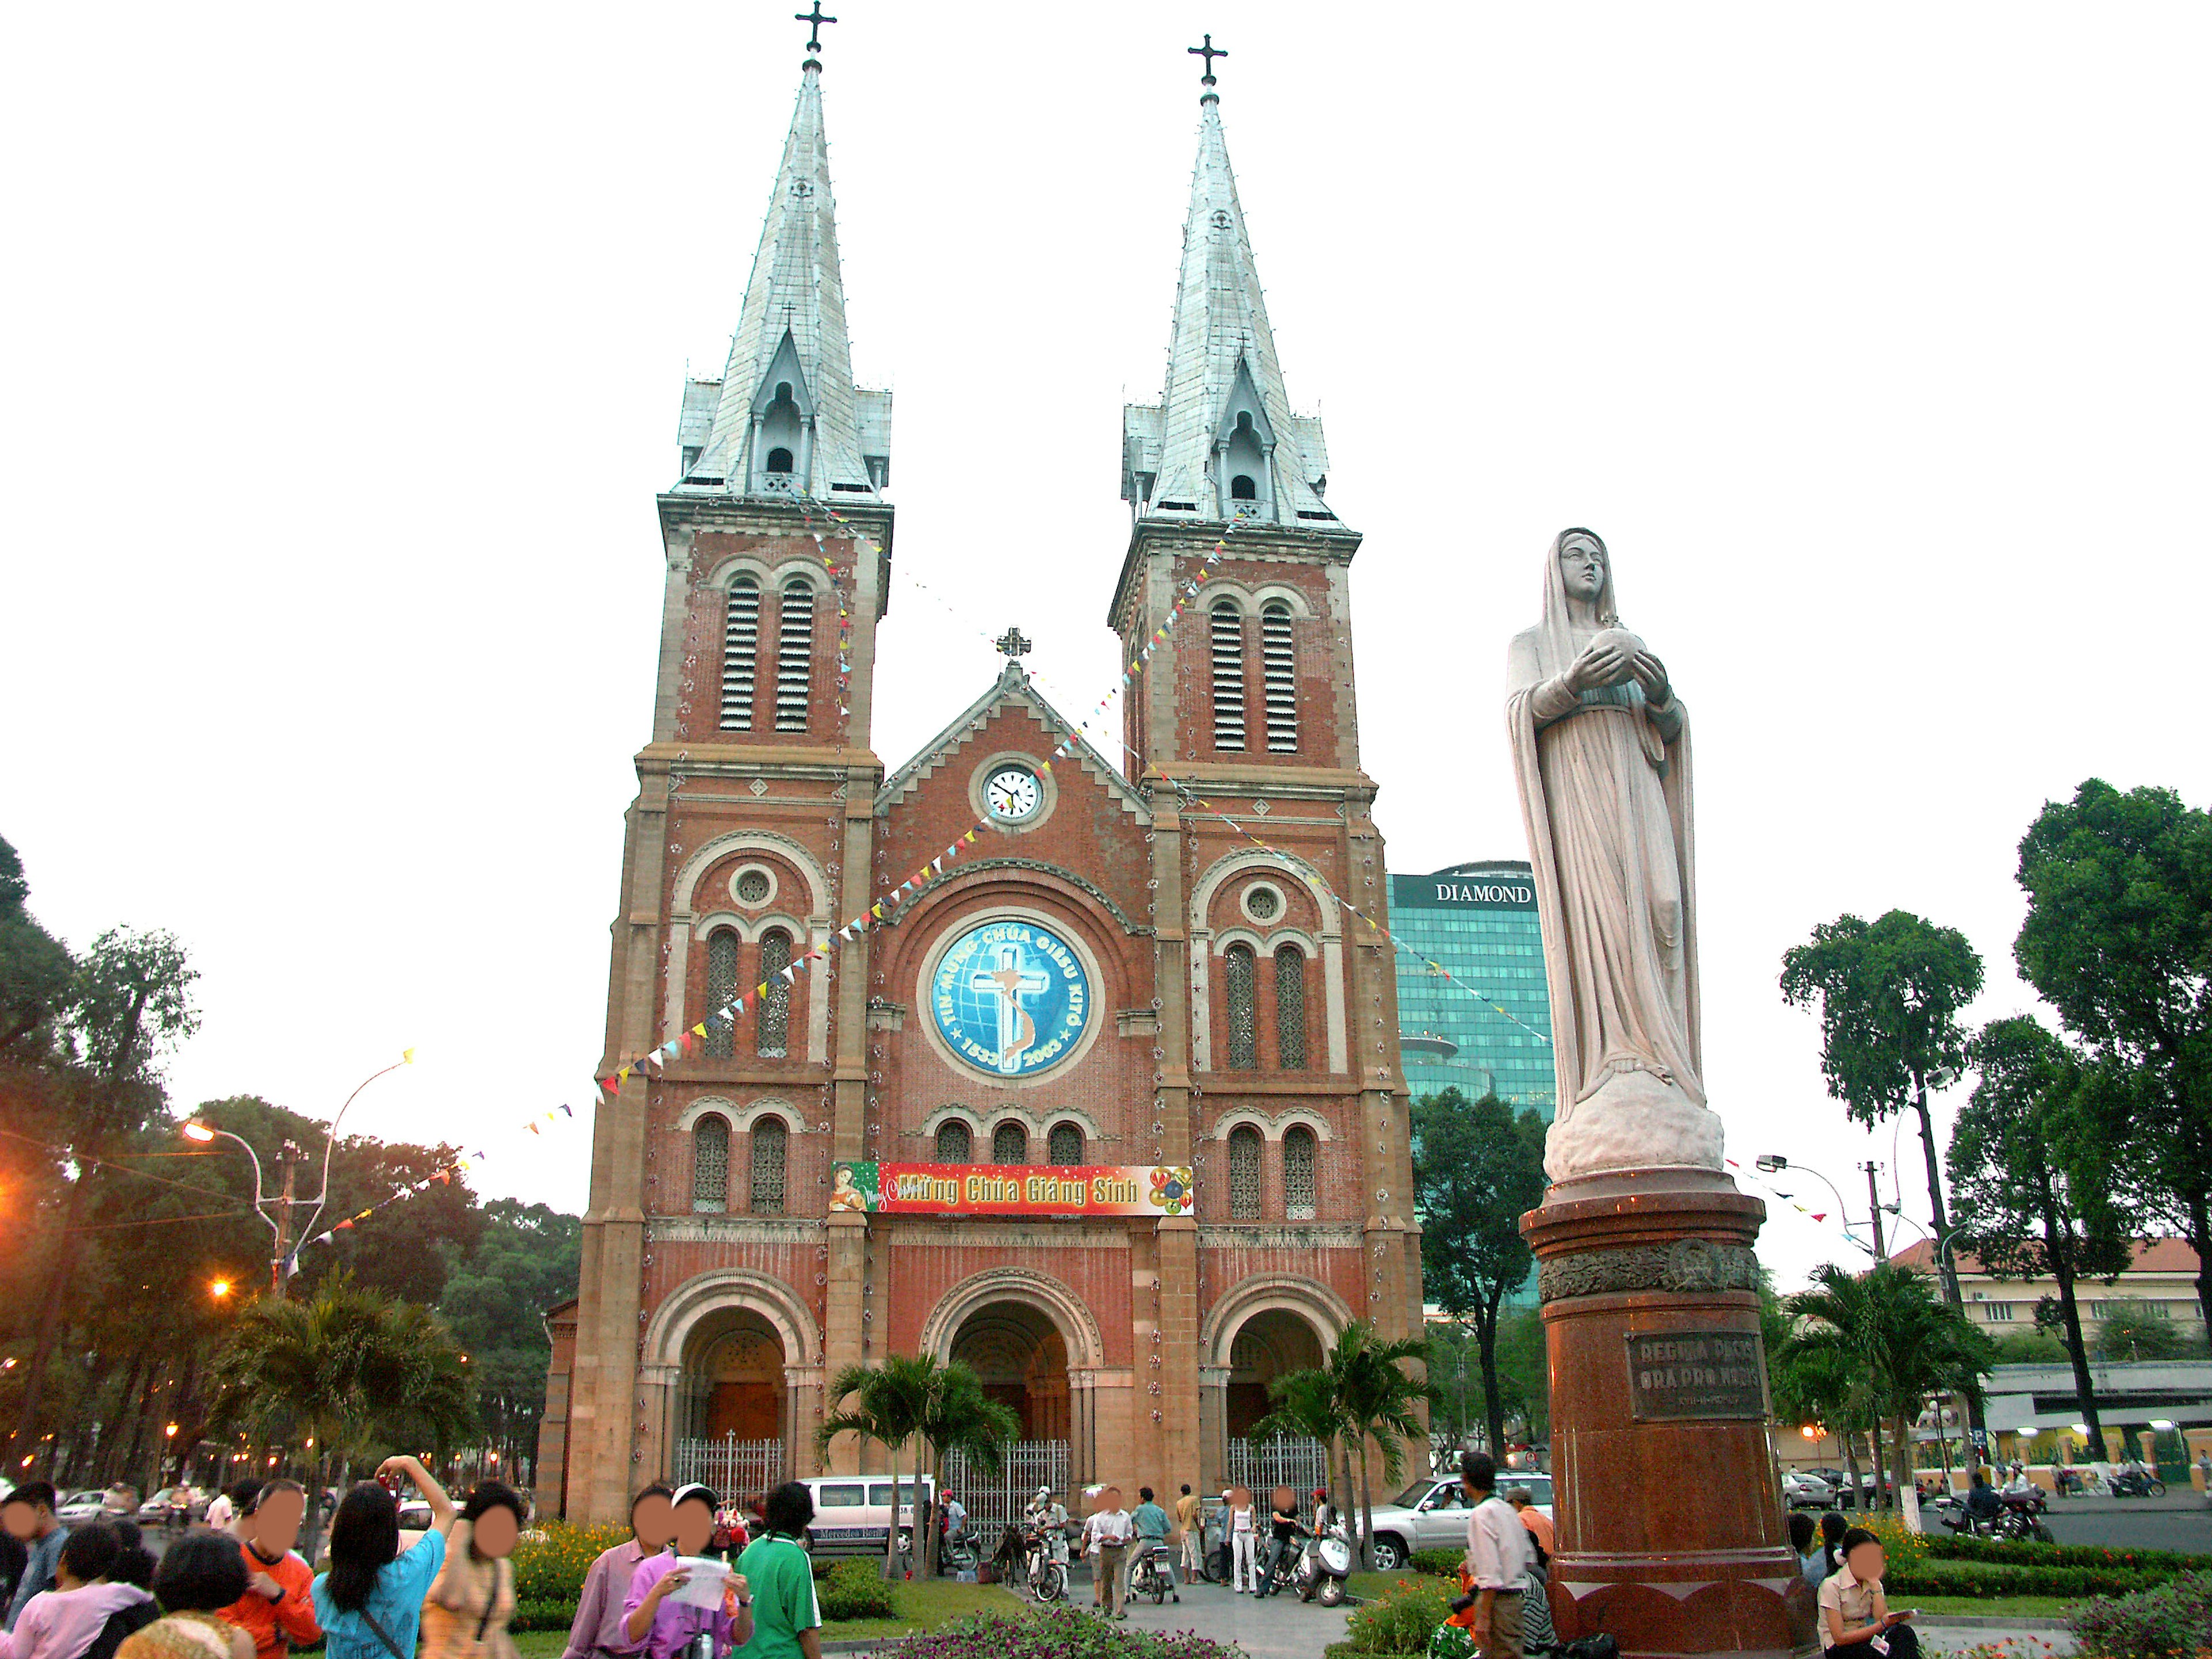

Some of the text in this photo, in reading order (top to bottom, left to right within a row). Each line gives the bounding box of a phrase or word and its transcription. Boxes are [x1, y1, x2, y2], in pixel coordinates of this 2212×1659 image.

[1435, 884, 1532, 903] DIAMOND
[939, 995, 956, 1026] TIN
[982, 924, 1031, 944] CHÚA
[1023, 1039, 1062, 1067] 2003
[897, 1175, 958, 1205] Mừng
[966, 1176, 1019, 1203] Chúa
[1027, 1176, 1085, 1206] Giáng
[1093, 1176, 1138, 1203] Sinh
[1641, 1368, 1677, 1389] ORA
[1974, 1430, 1983, 1441] P
